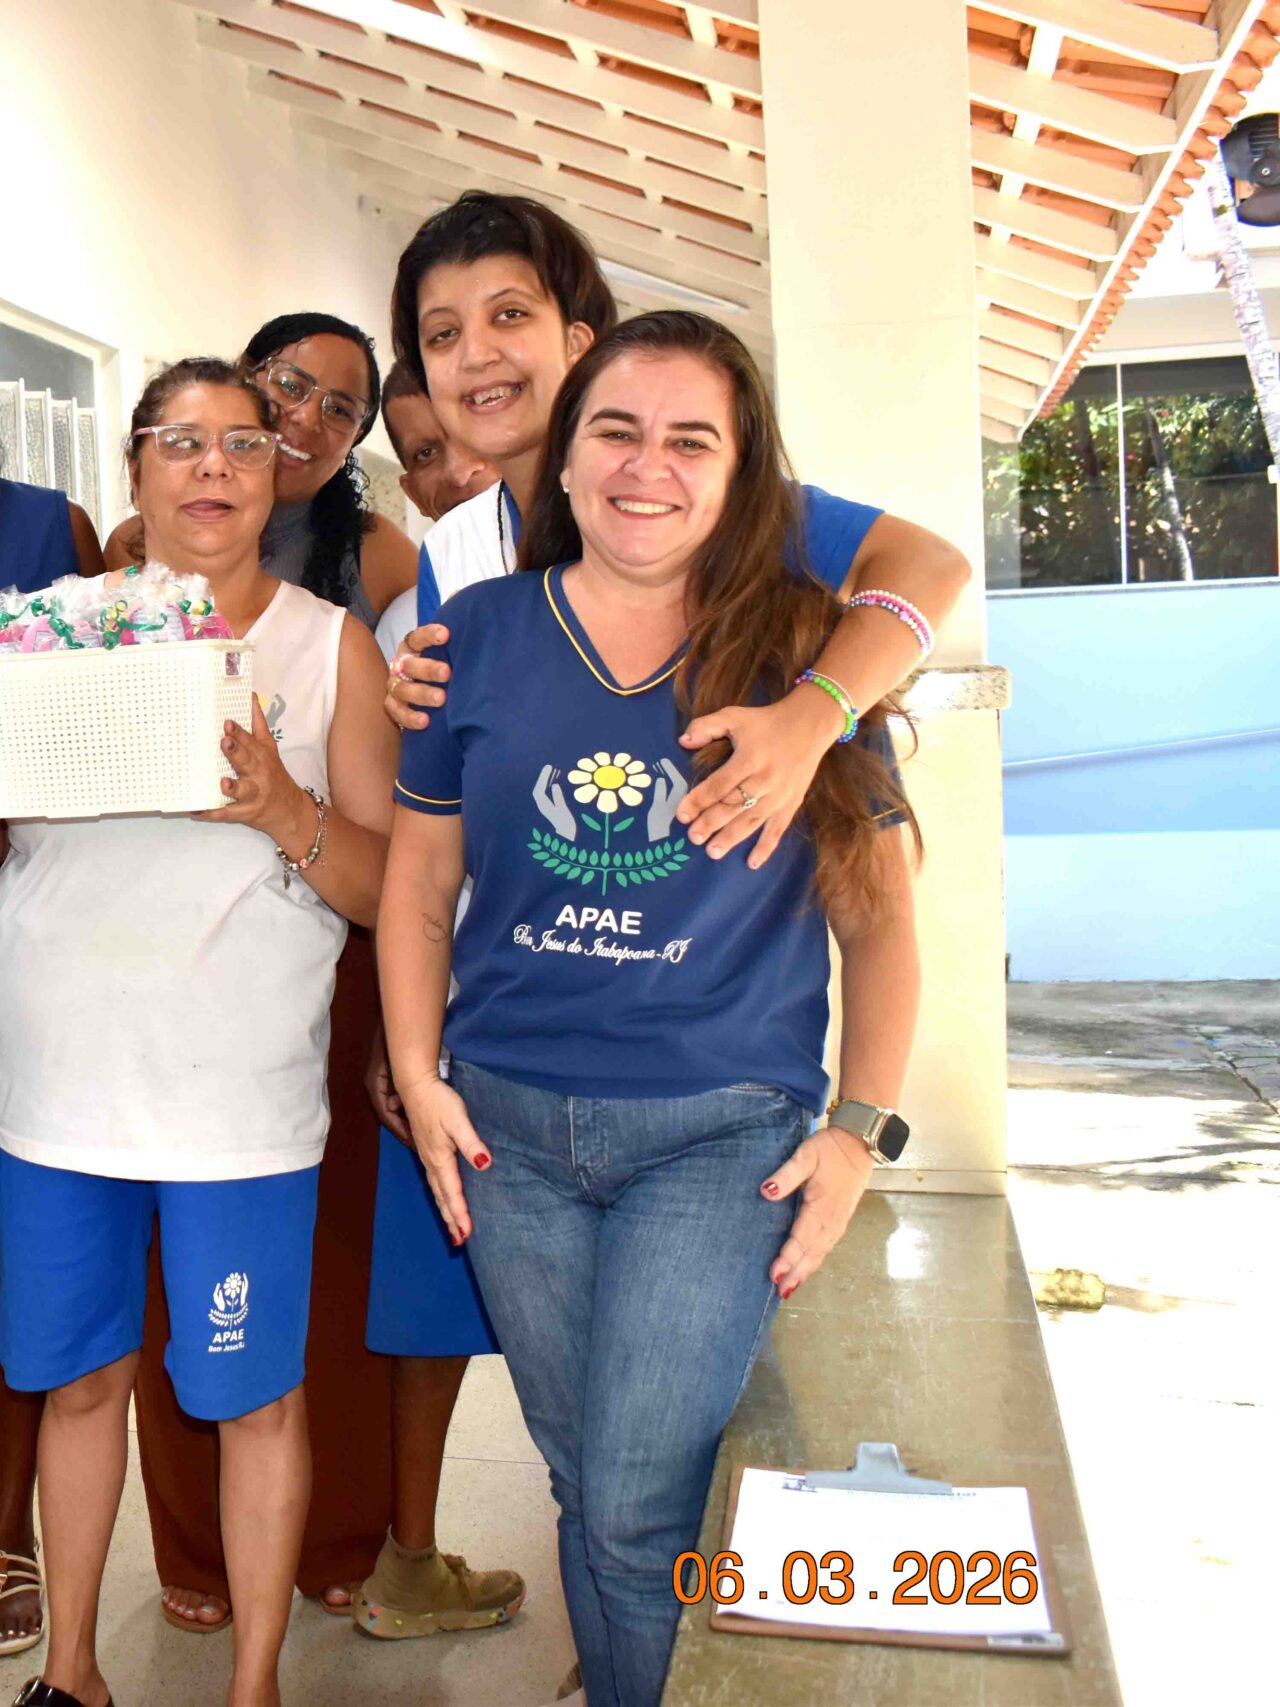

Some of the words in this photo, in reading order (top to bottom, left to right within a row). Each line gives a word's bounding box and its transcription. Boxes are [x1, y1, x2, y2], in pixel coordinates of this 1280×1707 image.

[555, 904, 643, 935] APAE
[531, 929, 567, 952] Jesus
[567, 937, 582, 953] do
[212, 1328, 245, 1344] APAE
